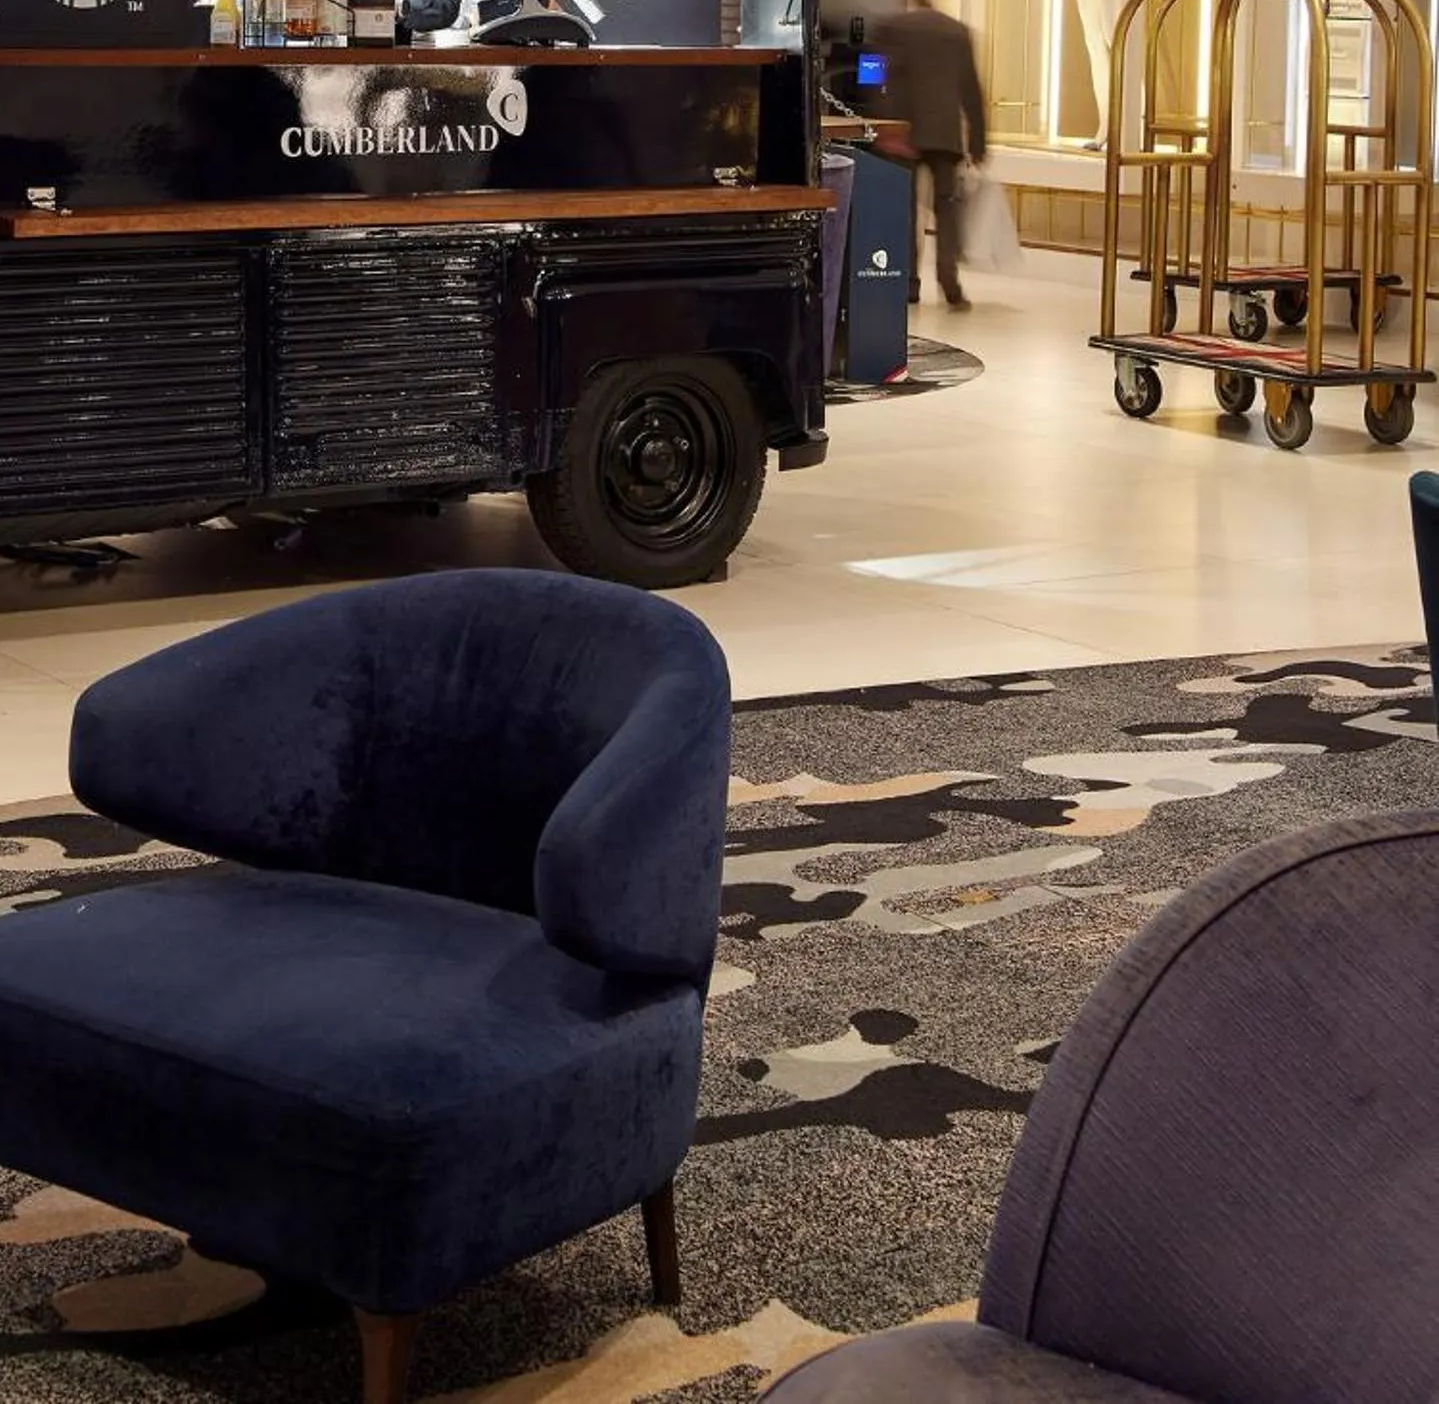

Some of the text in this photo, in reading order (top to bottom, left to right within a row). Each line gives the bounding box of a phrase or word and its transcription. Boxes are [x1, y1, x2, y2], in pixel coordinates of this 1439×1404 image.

[127, 0, 143, 12] TM
[498, 92, 520, 122] C
[280, 124, 500, 158] CUMBERLAND
